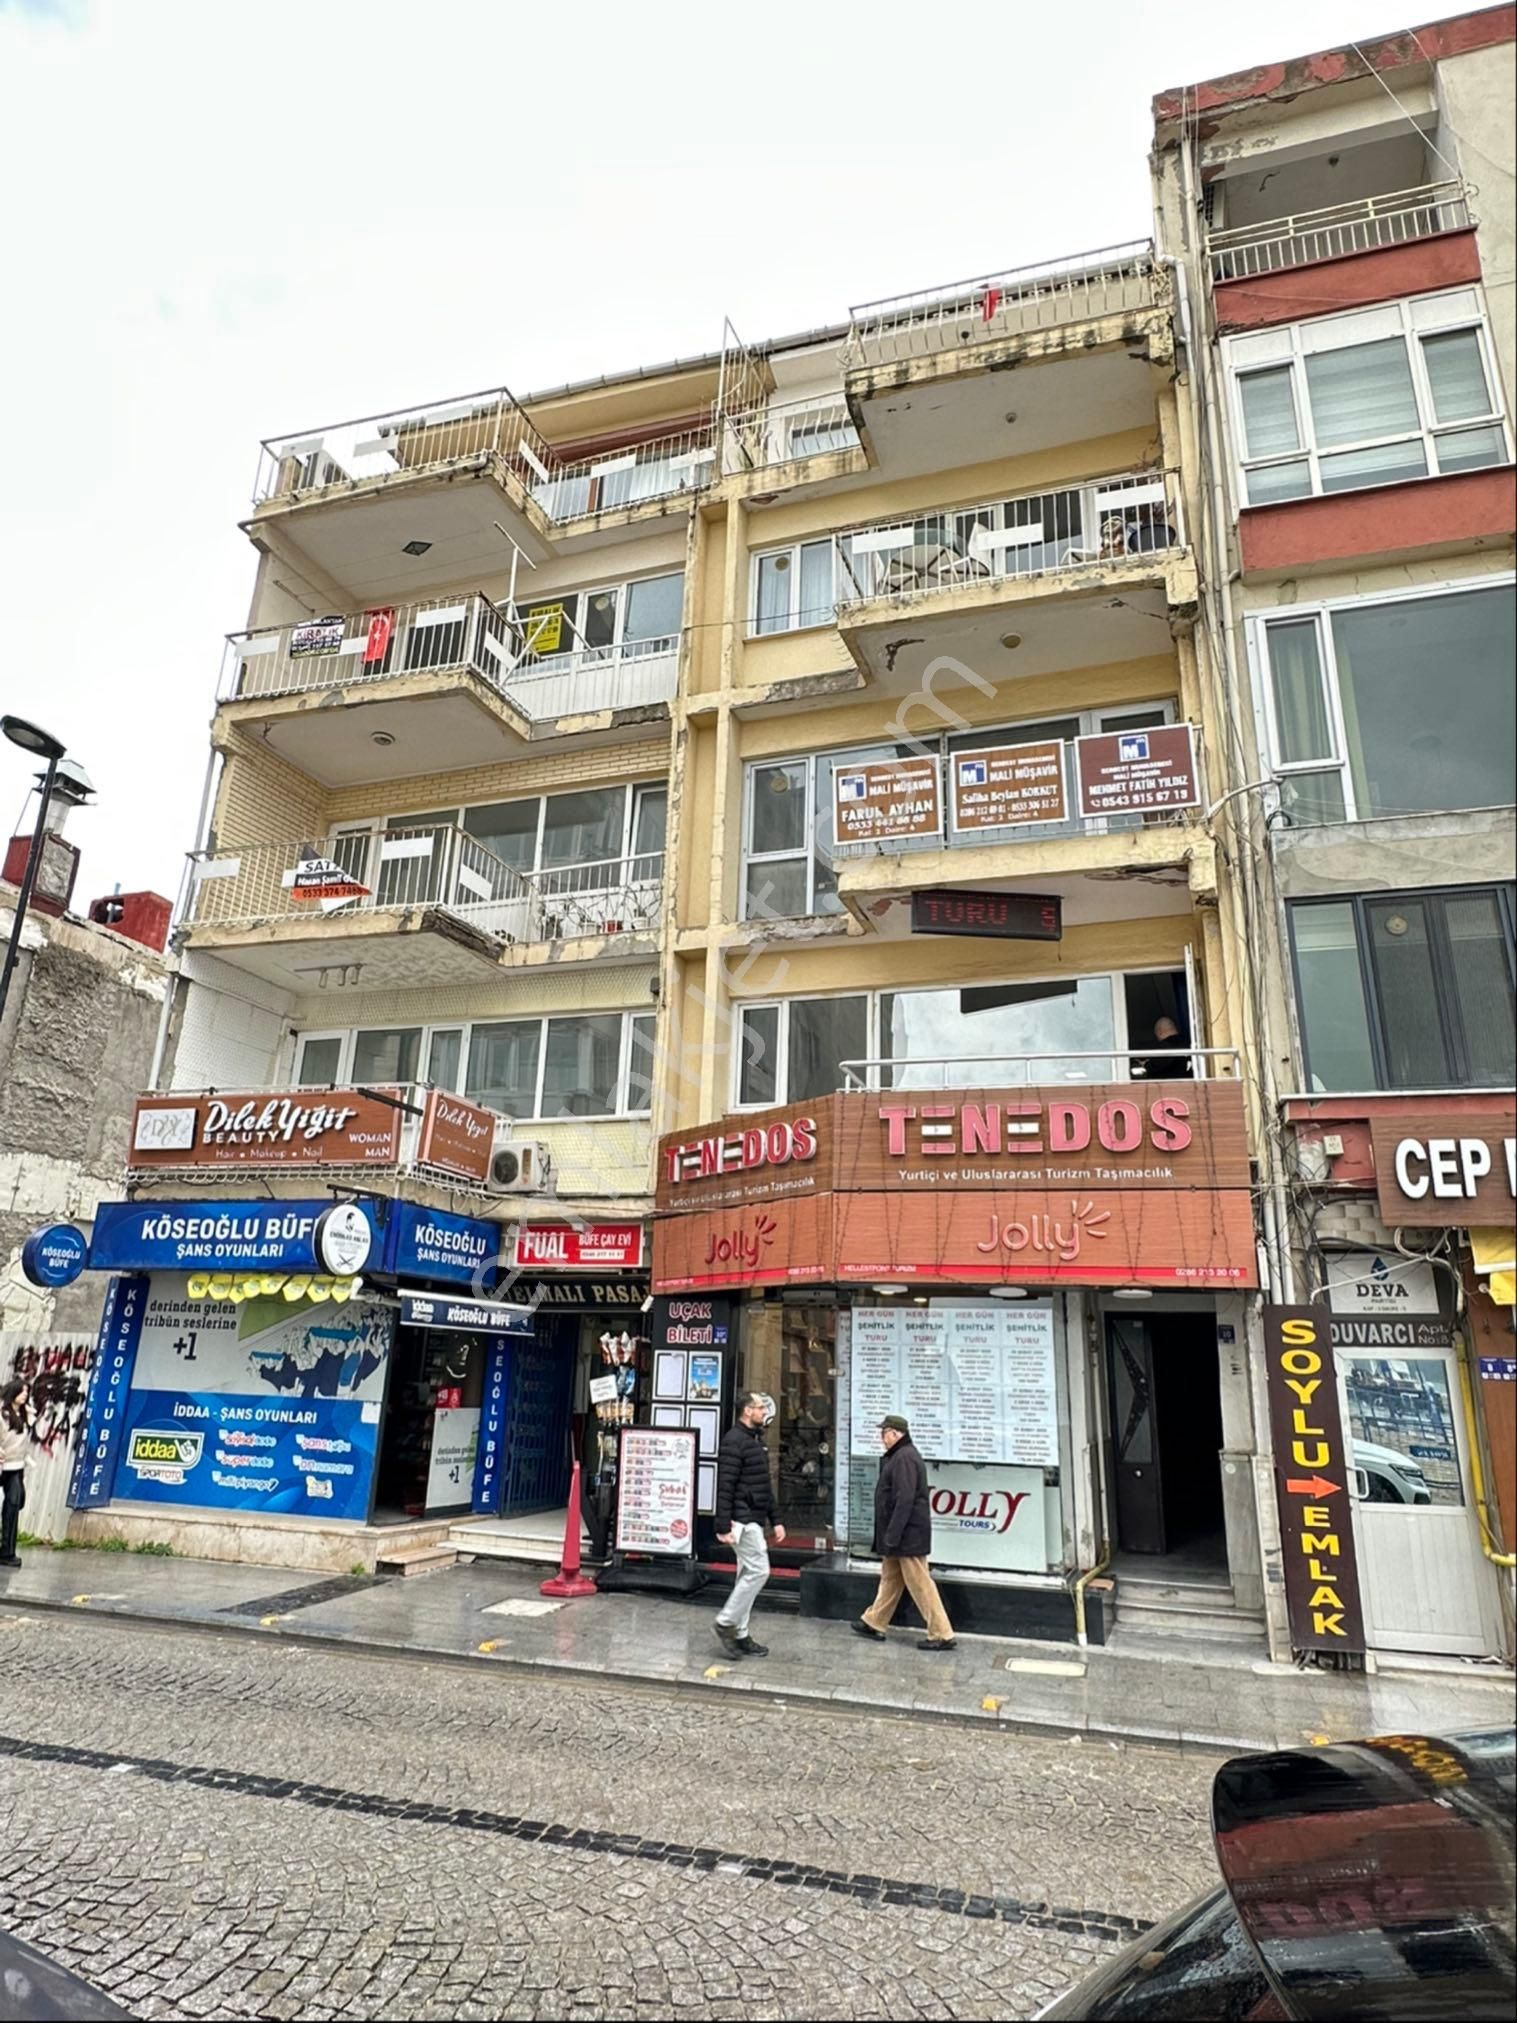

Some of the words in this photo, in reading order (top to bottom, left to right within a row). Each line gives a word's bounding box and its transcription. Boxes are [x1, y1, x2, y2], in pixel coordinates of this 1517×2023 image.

[990, 768, 1012, 782] MALİ
[1014, 764, 1058, 780] MÜŞAVİR
[869, 782, 890, 796] MALİ
[893, 780, 934, 794] MÜŞAVİR
[1088, 782, 1127, 796] MEHMET
[1129, 778, 1156, 792] FATİH
[1158, 776, 1188, 788] YILDIZ
[889, 800, 934, 817] AYHAN
[1102, 795, 1130, 808] 0543
[925, 900, 1008, 925] TURU
[204, 1100, 274, 1132] Dilek
[278, 1098, 358, 1140] Yiğit
[879, 1098, 1192, 1156] TENEDOS
[202, 1130, 280, 1144] BEAUTY
[349, 1132, 392, 1144] WOMAN
[364, 1146, 390, 1158] MAN
[664, 1118, 817, 1183] TENEDOS
[898, 1170, 940, 1182] Yurtiçi
[944, 1171, 958, 1180] ve
[962, 1168, 1041, 1180] Uluslararası
[1046, 1168, 1090, 1179] Turizm
[1094, 1167, 1173, 1180] Taşımacılık
[1394, 1138, 1492, 1199] CEP
[142, 1214, 261, 1240] KÖSEOĞLU
[414, 1223, 486, 1256] KÖSEOĞLU
[524, 1232, 568, 1259] FUAL
[578, 1232, 600, 1246] BÜFE
[600, 1234, 616, 1248] ÇAY
[618, 1232, 632, 1246] EVİ
[977, 1214, 1080, 1260] Jolly
[42, 1246, 80, 1260] KÖSEOĞLU
[176, 1243, 212, 1259] ŞANS
[215, 1243, 283, 1259] OYUNLARI
[416, 1246, 440, 1262] ŞANS
[440, 1250, 480, 1270] OYUNLARI
[705, 1230, 760, 1268] Jolly
[49, 1258, 69, 1268] BÜFE
[1356, 1284, 1409, 1298] DEVA
[150, 1300, 202, 1313] derinden
[204, 1302, 236, 1317] gelen
[669, 1302, 712, 1322] UÇAK
[858, 1310, 874, 1318] HER
[145, 1316, 180, 1328] tribün
[183, 1316, 237, 1330] seslerine
[858, 1322, 895, 1330] ŞEHİTLİK
[905, 1322, 944, 1331] ŞEHİTLİK
[956, 1323, 995, 1332] ŞEHİTLİK
[1006, 1324, 1048, 1332] ŞEHİTLİK
[666, 1324, 713, 1344] BİLETİ
[864, 1334, 888, 1342] TURU
[963, 1336, 988, 1344] TURU
[1330, 1323, 1415, 1344] DUVARCI
[104, 1288, 136, 1420] KÖSEOĞLU
[173, 1332, 198, 1360] +1
[488, 1340, 504, 1433] SEOĞLU
[1282, 1317, 1331, 1469] SOYLU
[174, 1402, 210, 1418] İDDAA
[220, 1406, 253, 1422] ŞANS
[255, 1408, 317, 1424] OYUNLARI
[135, 1438, 177, 1459] iddaa
[90, 1429, 110, 1495] BÜFE
[959, 1520, 990, 1528] TOURS
[1302, 1506, 1348, 1636] EMLAK
